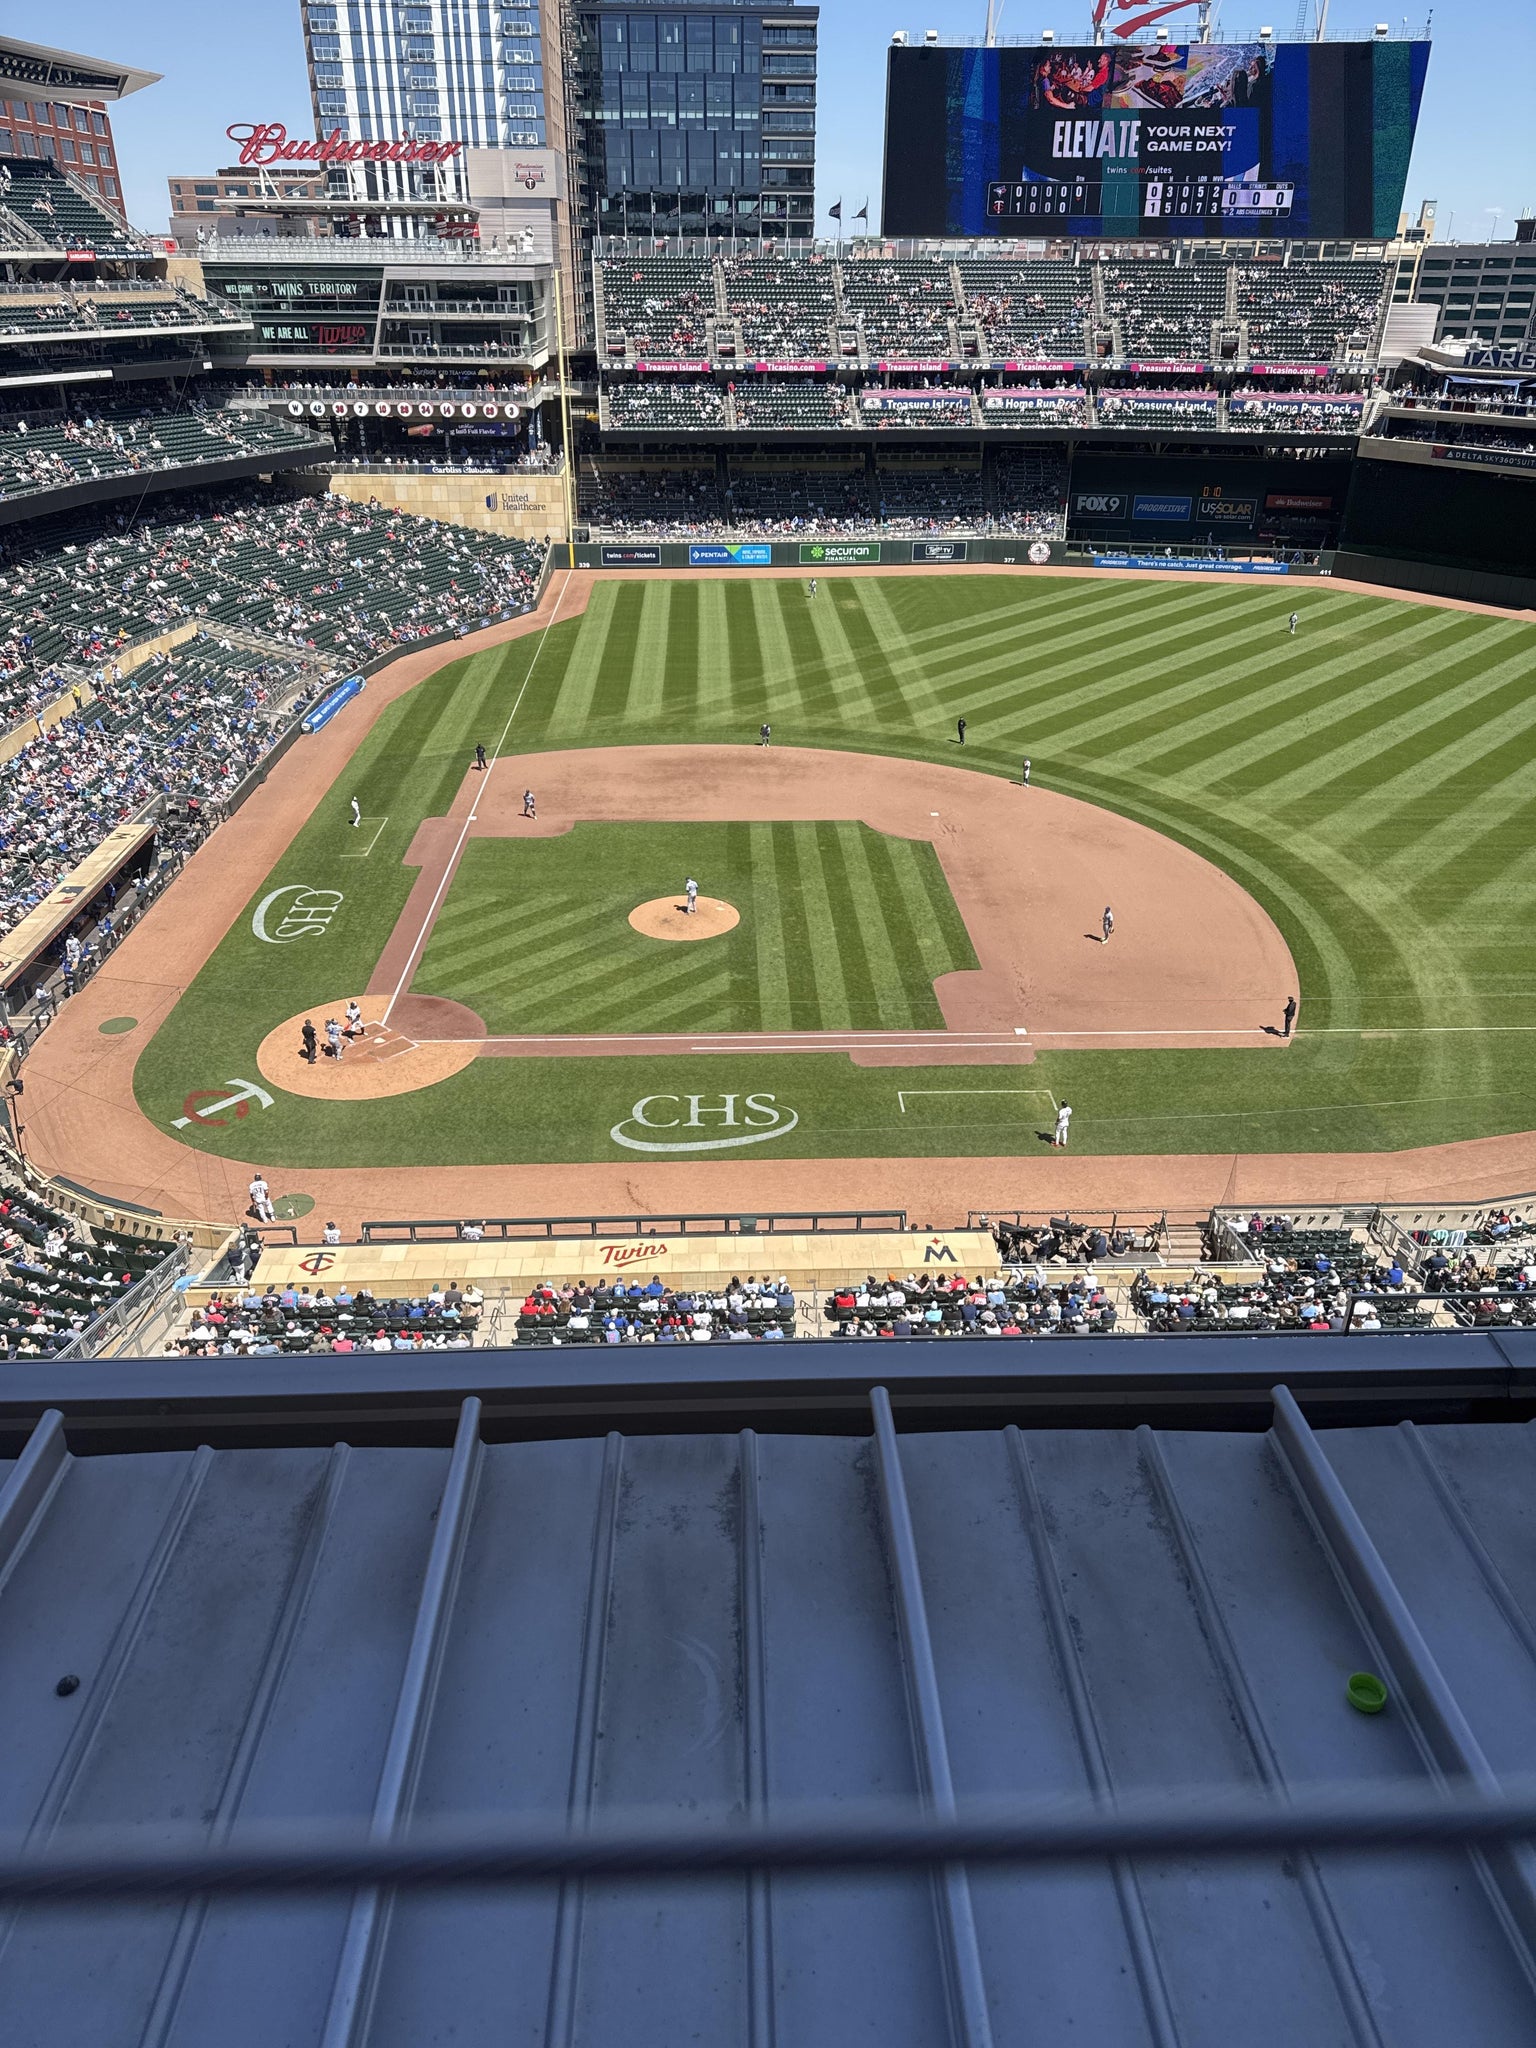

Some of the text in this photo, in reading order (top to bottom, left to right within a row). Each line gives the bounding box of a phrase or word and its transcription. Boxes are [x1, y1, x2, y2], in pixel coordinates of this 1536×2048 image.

[1147, 126, 1236, 137] YOUR NEXT
[226, 123, 463, 165] Budweiser
[1052, 120, 1141, 158] ELEVATE
[1147, 141, 1232, 152] GAME DAY!
[1107, 165, 1172, 175] twinscom/suites
[1016, 186, 1220, 198] 0 0 0 0 0 0 3 0 5 2
[1229, 192, 1284, 205] 0 0 0
[1016, 202, 1218, 214] 1 0 0 0 1 5 0 7 3
[1246, 208, 1273, 216] CHALLENGES
[225, 284, 254, 294] WELCOME
[272, 283, 304, 296] TWINS
[308, 283, 358, 295] TERRITORY
[262, 326, 276, 340] WE
[278, 326, 292, 340] ARE
[294, 326, 308, 340] ALL
[1465, 350, 1536, 369] TARG
[1138, 364, 1196, 373] Treasure Island
[292, 404, 299, 412] W
[313, 405, 322, 413] 42
[358, 405, 363, 414] 7
[379, 405, 387, 413] 10
[421, 406, 430, 414] 34
[444, 406, 451, 414] 14
[510, 407, 514, 415] 3
[1006, 399, 1034, 409] Home
[1036, 399, 1056, 409] Run
[1130, 400, 1174, 410] Treasure
[1268, 402, 1298, 412] Home
[1328, 404, 1352, 414] Deck
[1456, 452, 1482, 461] DELTA
[432, 466, 500, 474] Carbliss Clubhouse
[502, 493, 529, 502] United
[1286, 499, 1323, 507] Budweiser
[502, 501, 546, 511] Healthcare
[1077, 496, 1120, 513] FOX 9
[1136, 503, 1188, 513] PROGRESSIVE
[824, 546, 870, 556] securian
[270, 889, 344, 938] CHS
[631, 1092, 780, 1129] CHS
[600, 1242, 668, 1266] Twins
[924, 1245, 958, 1262] M
